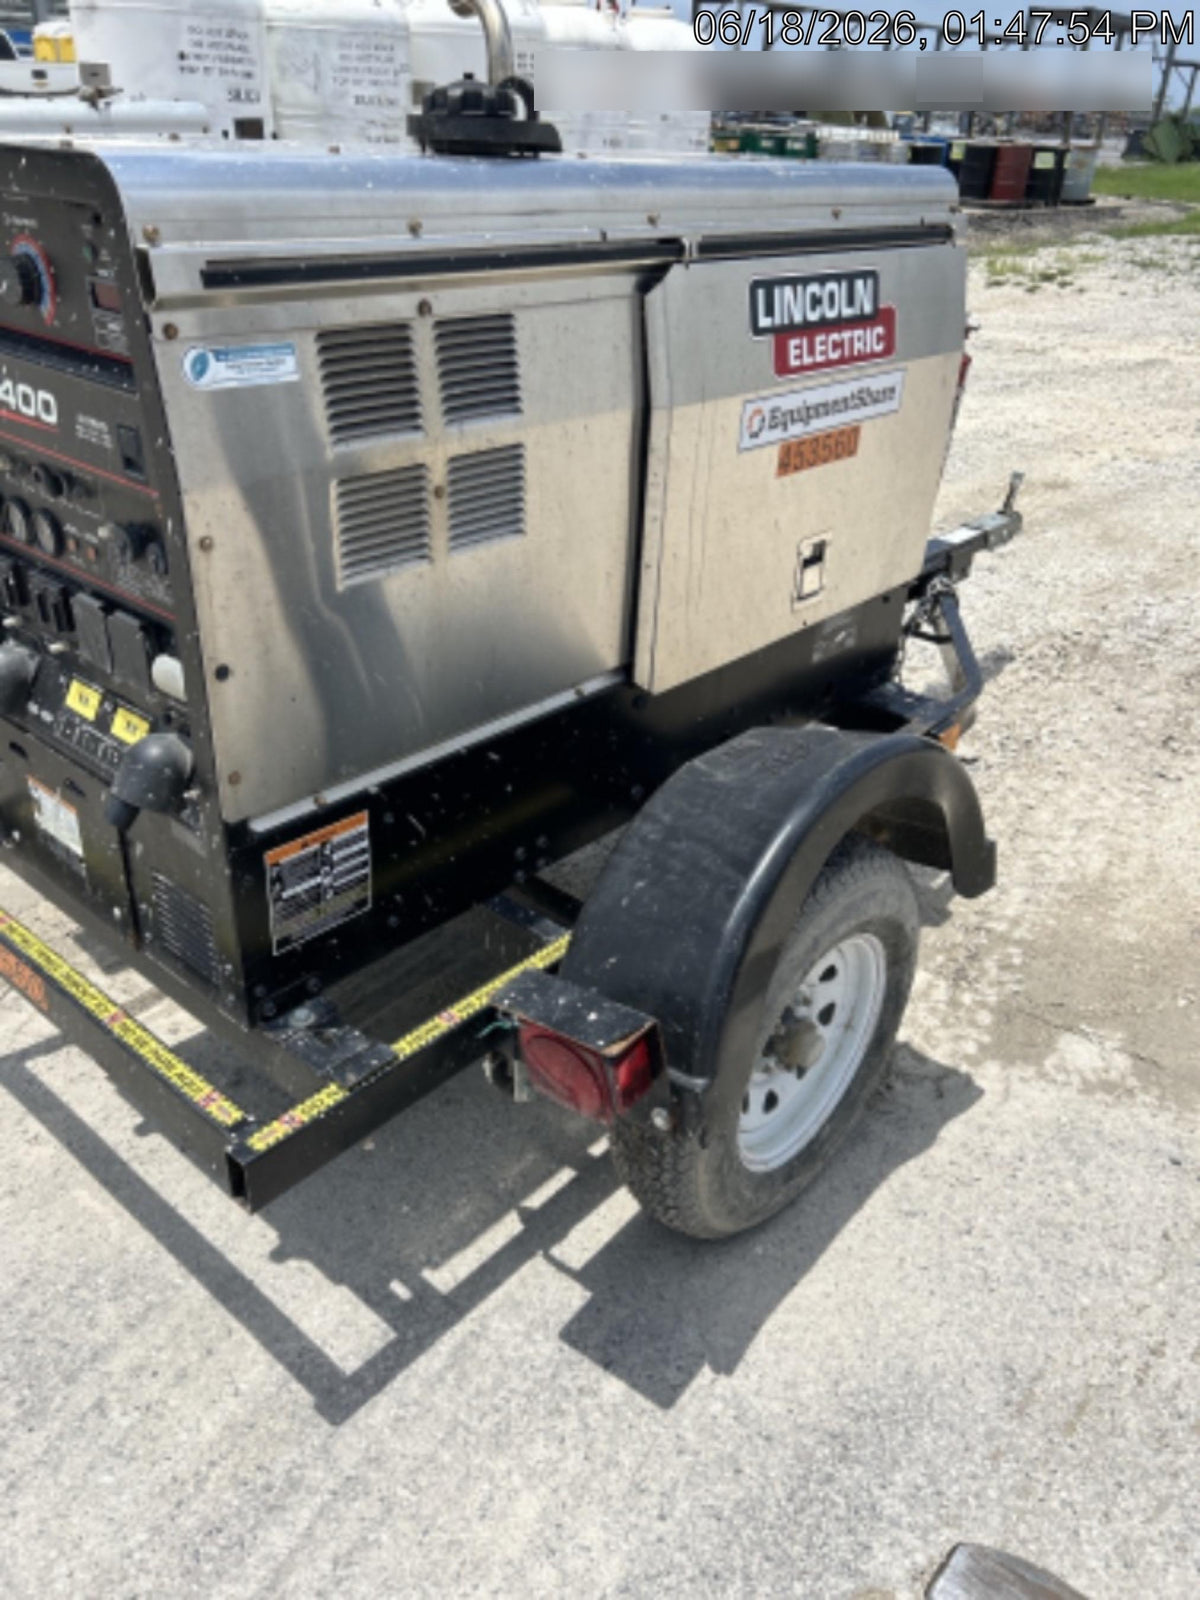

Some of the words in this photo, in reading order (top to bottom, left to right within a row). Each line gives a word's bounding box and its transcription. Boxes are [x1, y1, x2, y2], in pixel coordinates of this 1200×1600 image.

[757, 277, 874, 328] LINCOLN
[788, 326, 886, 368] ELECTRIC
[0, 378, 58, 424] 400
[768, 385, 896, 432] EquipmentShare
[777, 429, 859, 474] 453560
